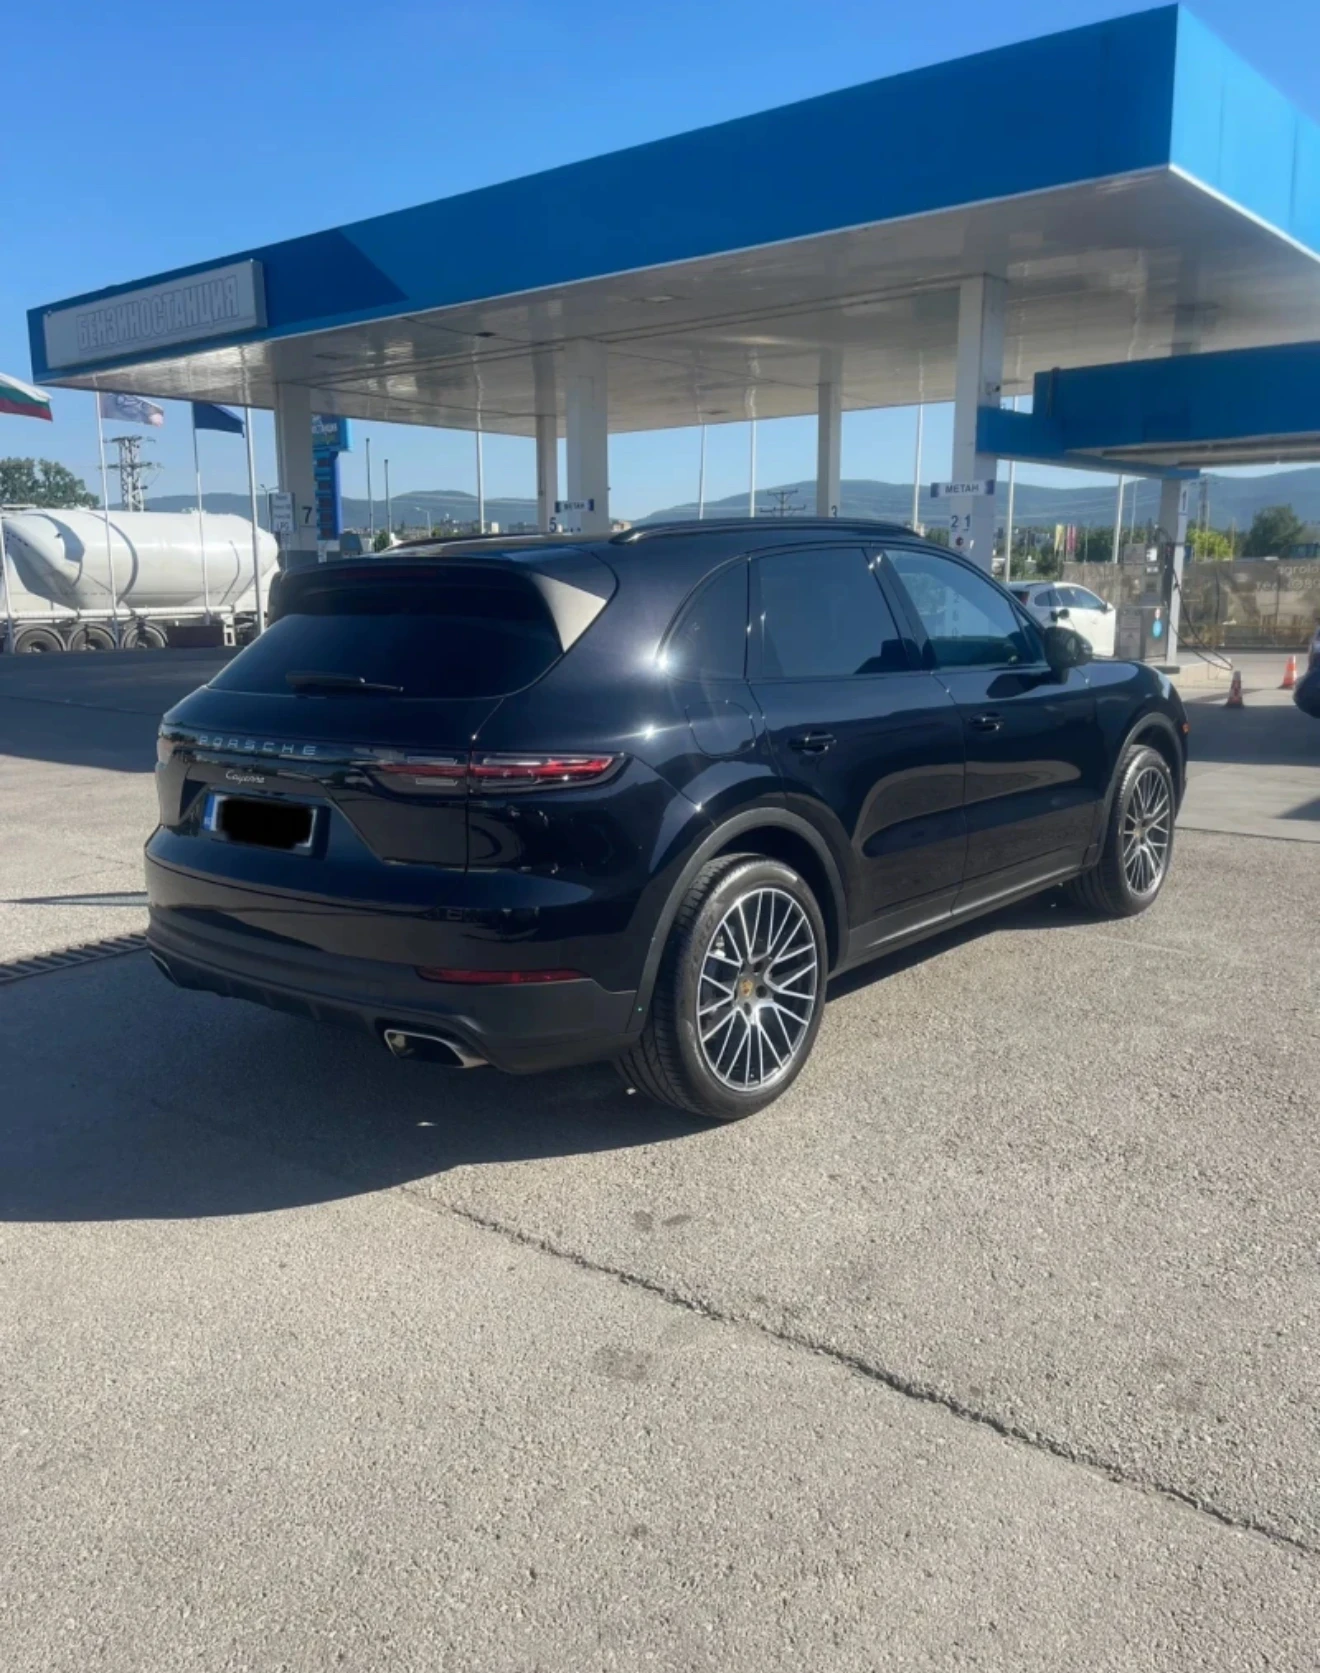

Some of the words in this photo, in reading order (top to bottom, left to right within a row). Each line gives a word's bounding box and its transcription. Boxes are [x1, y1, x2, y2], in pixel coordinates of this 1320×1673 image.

[76, 274, 240, 350] БЕНЗИНОСТАНЦИЯ
[301, 506, 312, 525] 7
[549, 516, 557, 533] 5
[198, 735, 317, 756] PORSCHE
[225, 769, 265, 785] Cayenne
